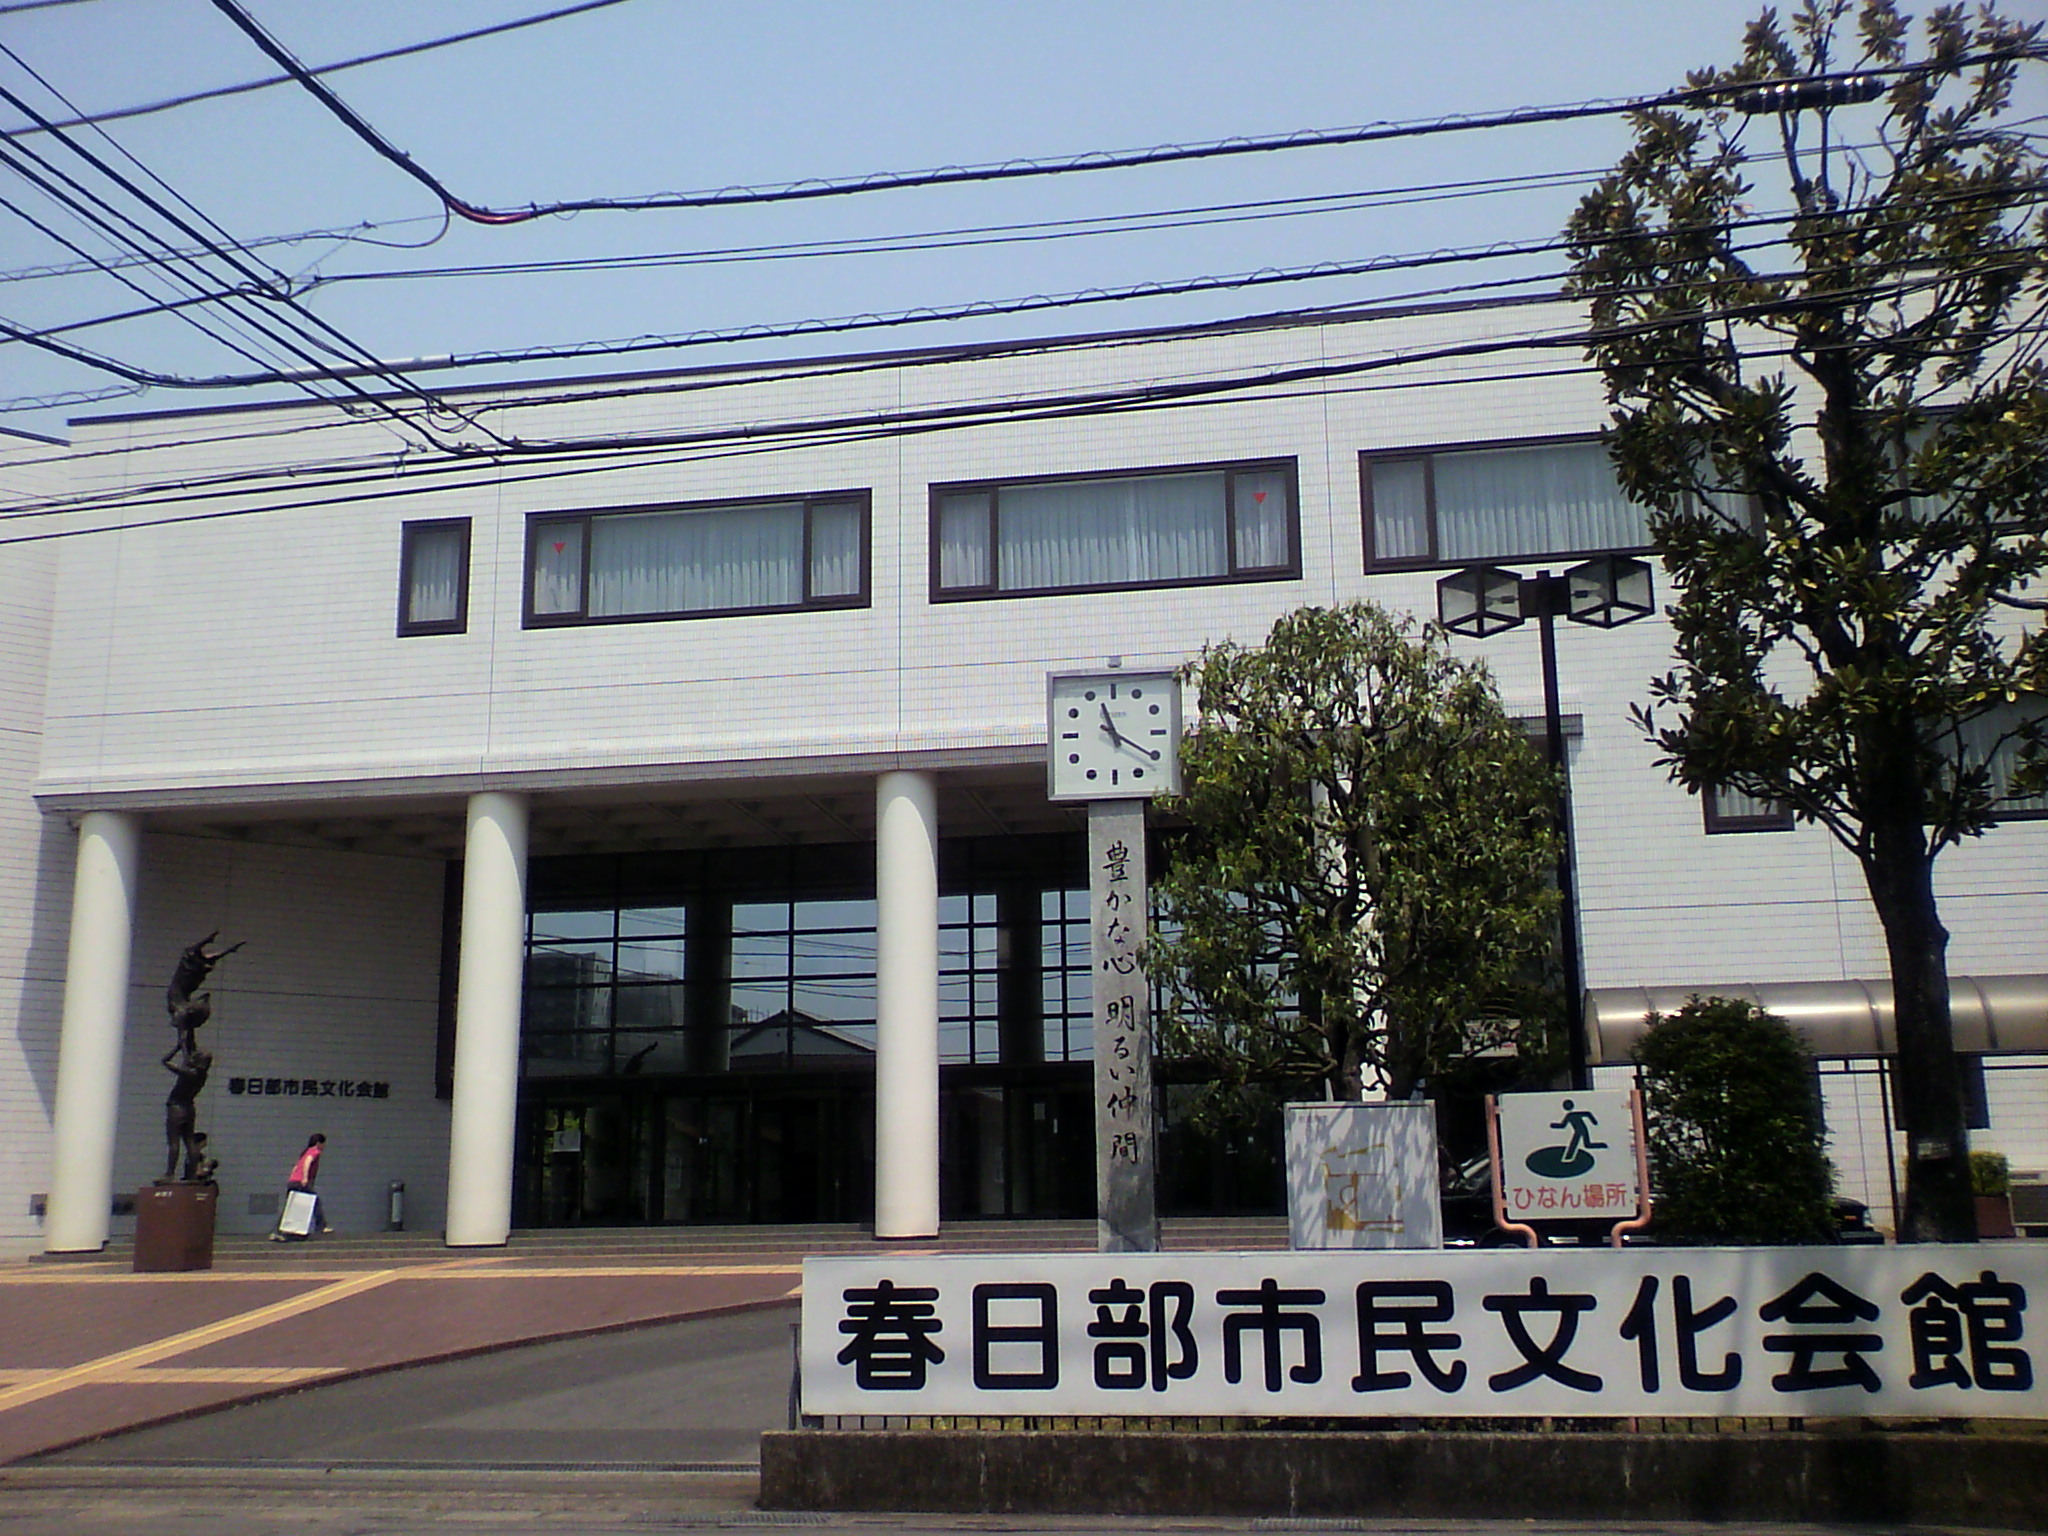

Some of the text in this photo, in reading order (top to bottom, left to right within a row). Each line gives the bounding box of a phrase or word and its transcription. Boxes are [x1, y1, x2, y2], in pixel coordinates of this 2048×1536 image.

[1103, 839, 1138, 1166] 豊かな心 明るい仲間
[229, 1077, 390, 1099] 春日部市民文化会館
[1513, 1183, 1627, 1210] ひなん場所
[837, 1270, 2034, 1393] 春日部市民文化会館
